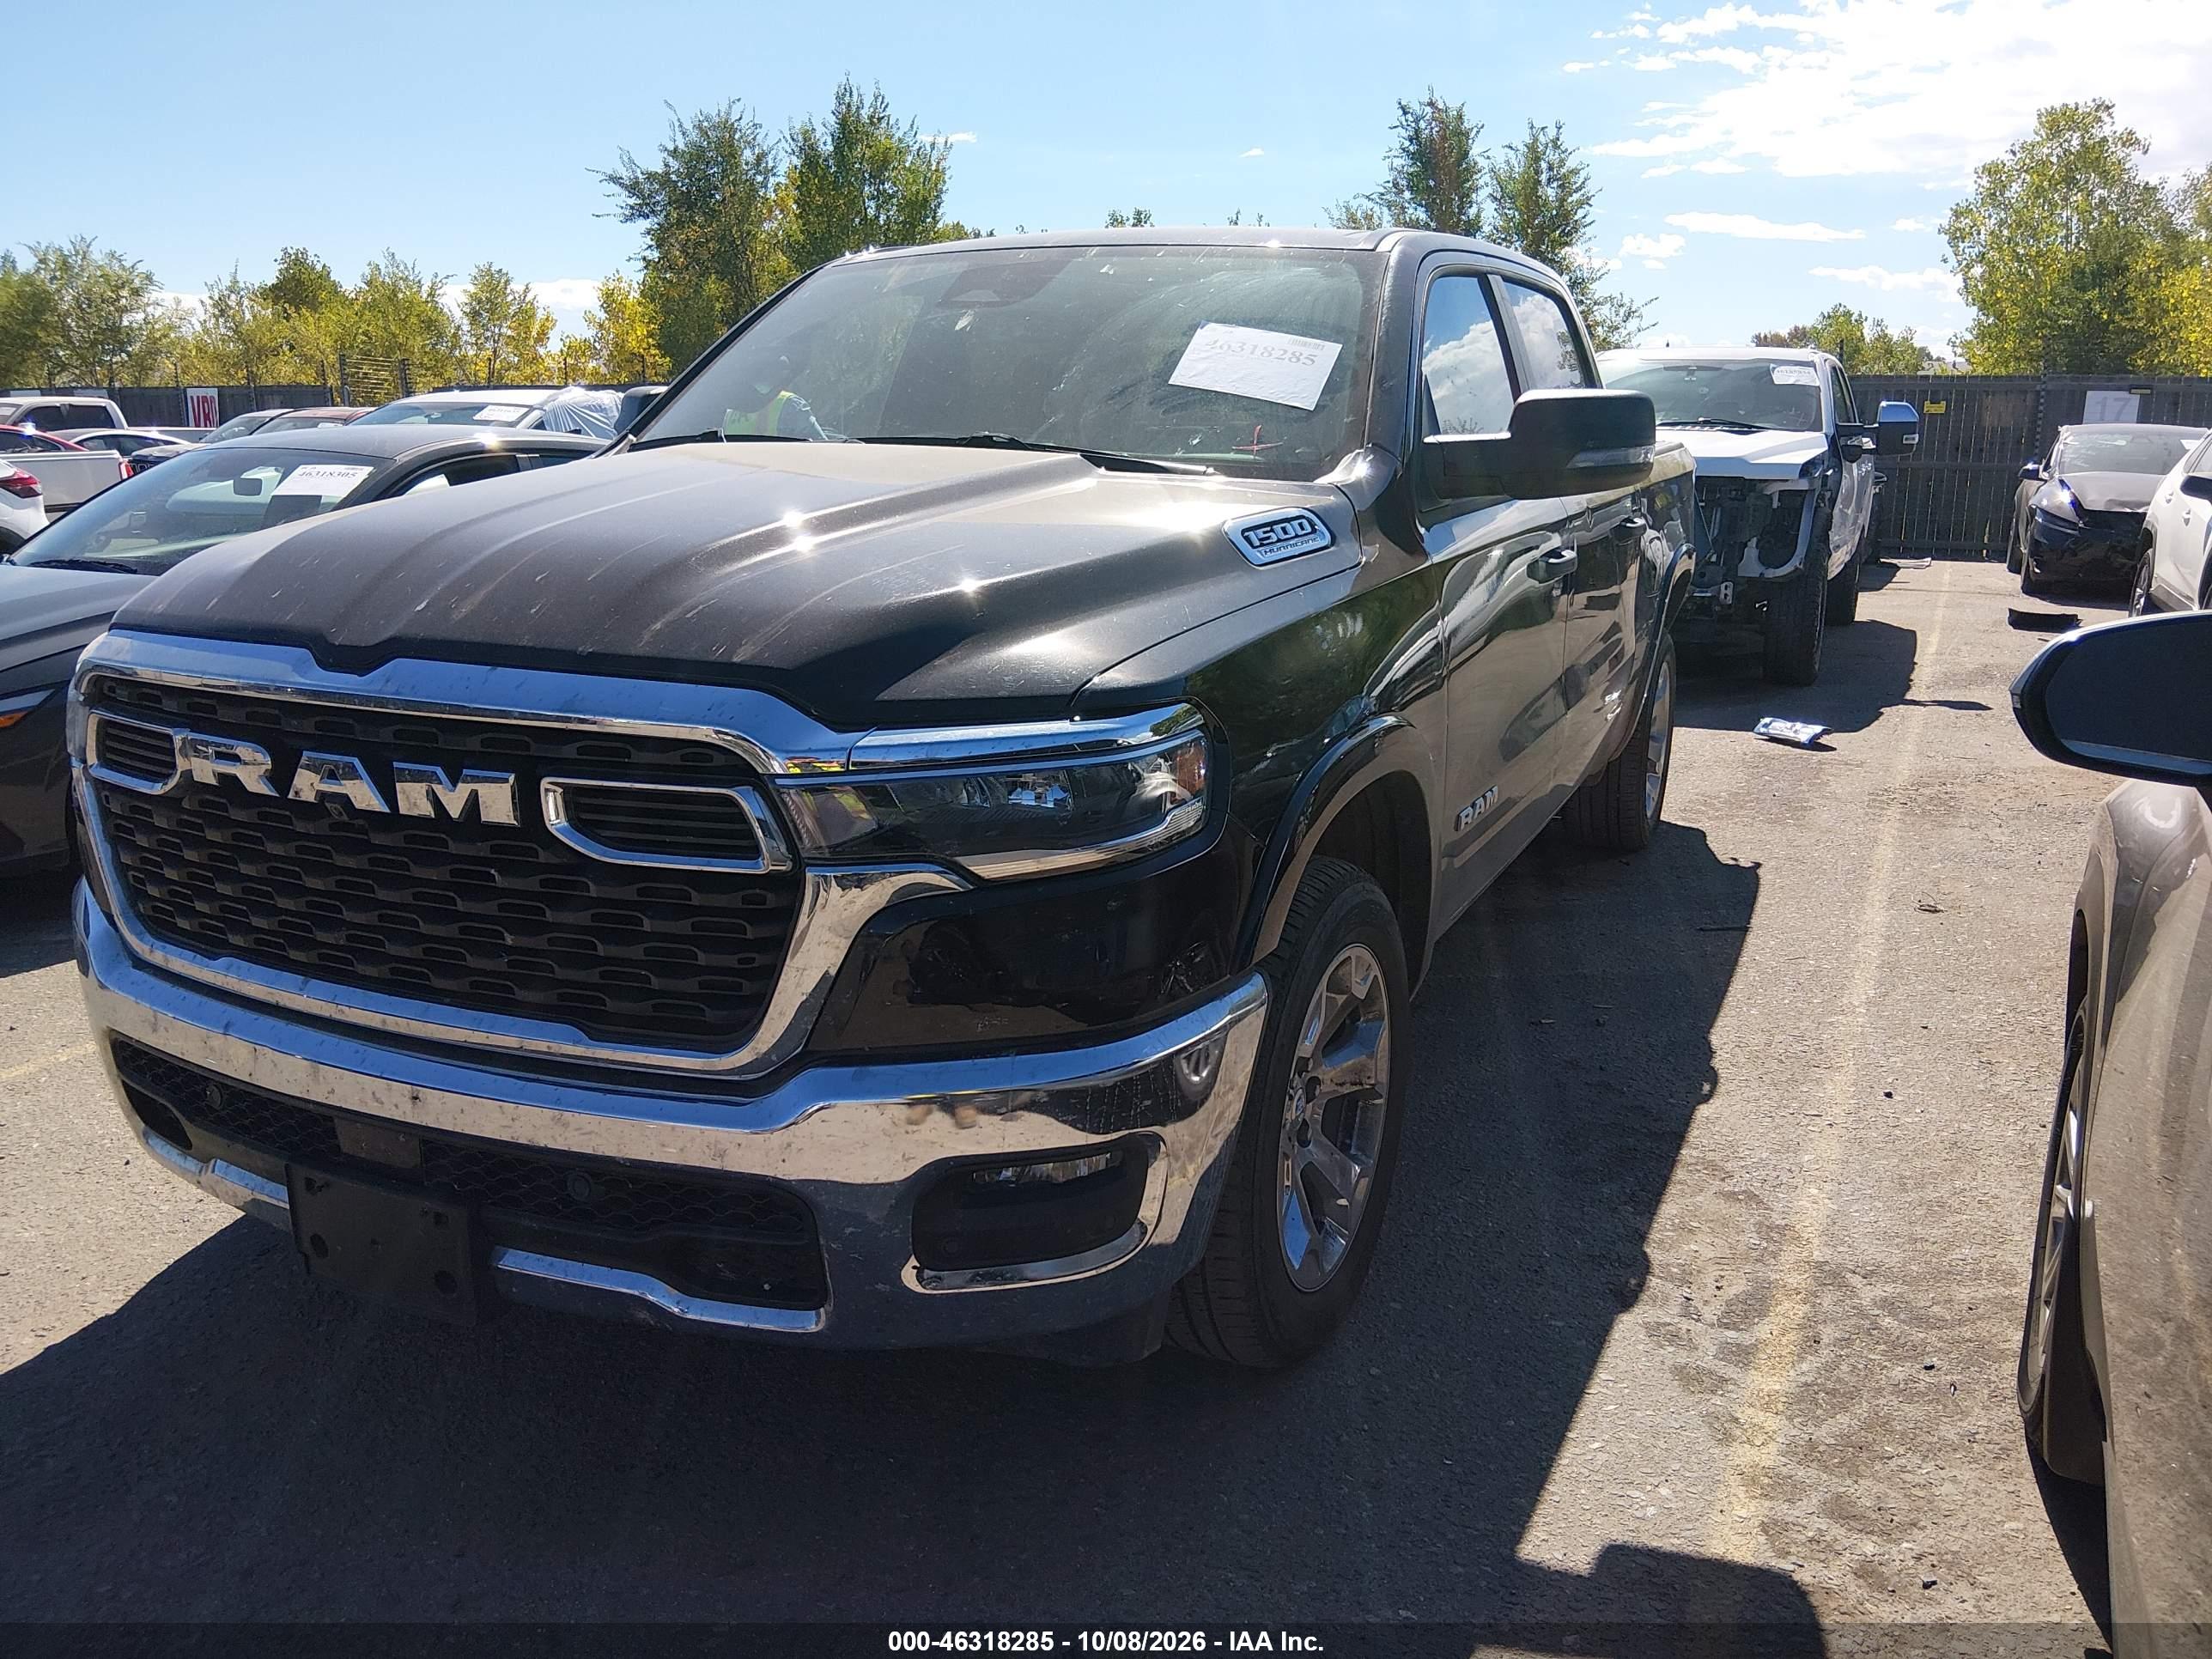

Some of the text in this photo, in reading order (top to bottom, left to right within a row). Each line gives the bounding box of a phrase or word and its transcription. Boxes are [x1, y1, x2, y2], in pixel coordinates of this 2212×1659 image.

[2096, 397, 2132, 421] 17
[1243, 518, 1312, 546] 1500
[1263, 536, 1321, 556] HURRICANE
[184, 731, 520, 827] RAM
[1453, 784, 1498, 831] RAM
